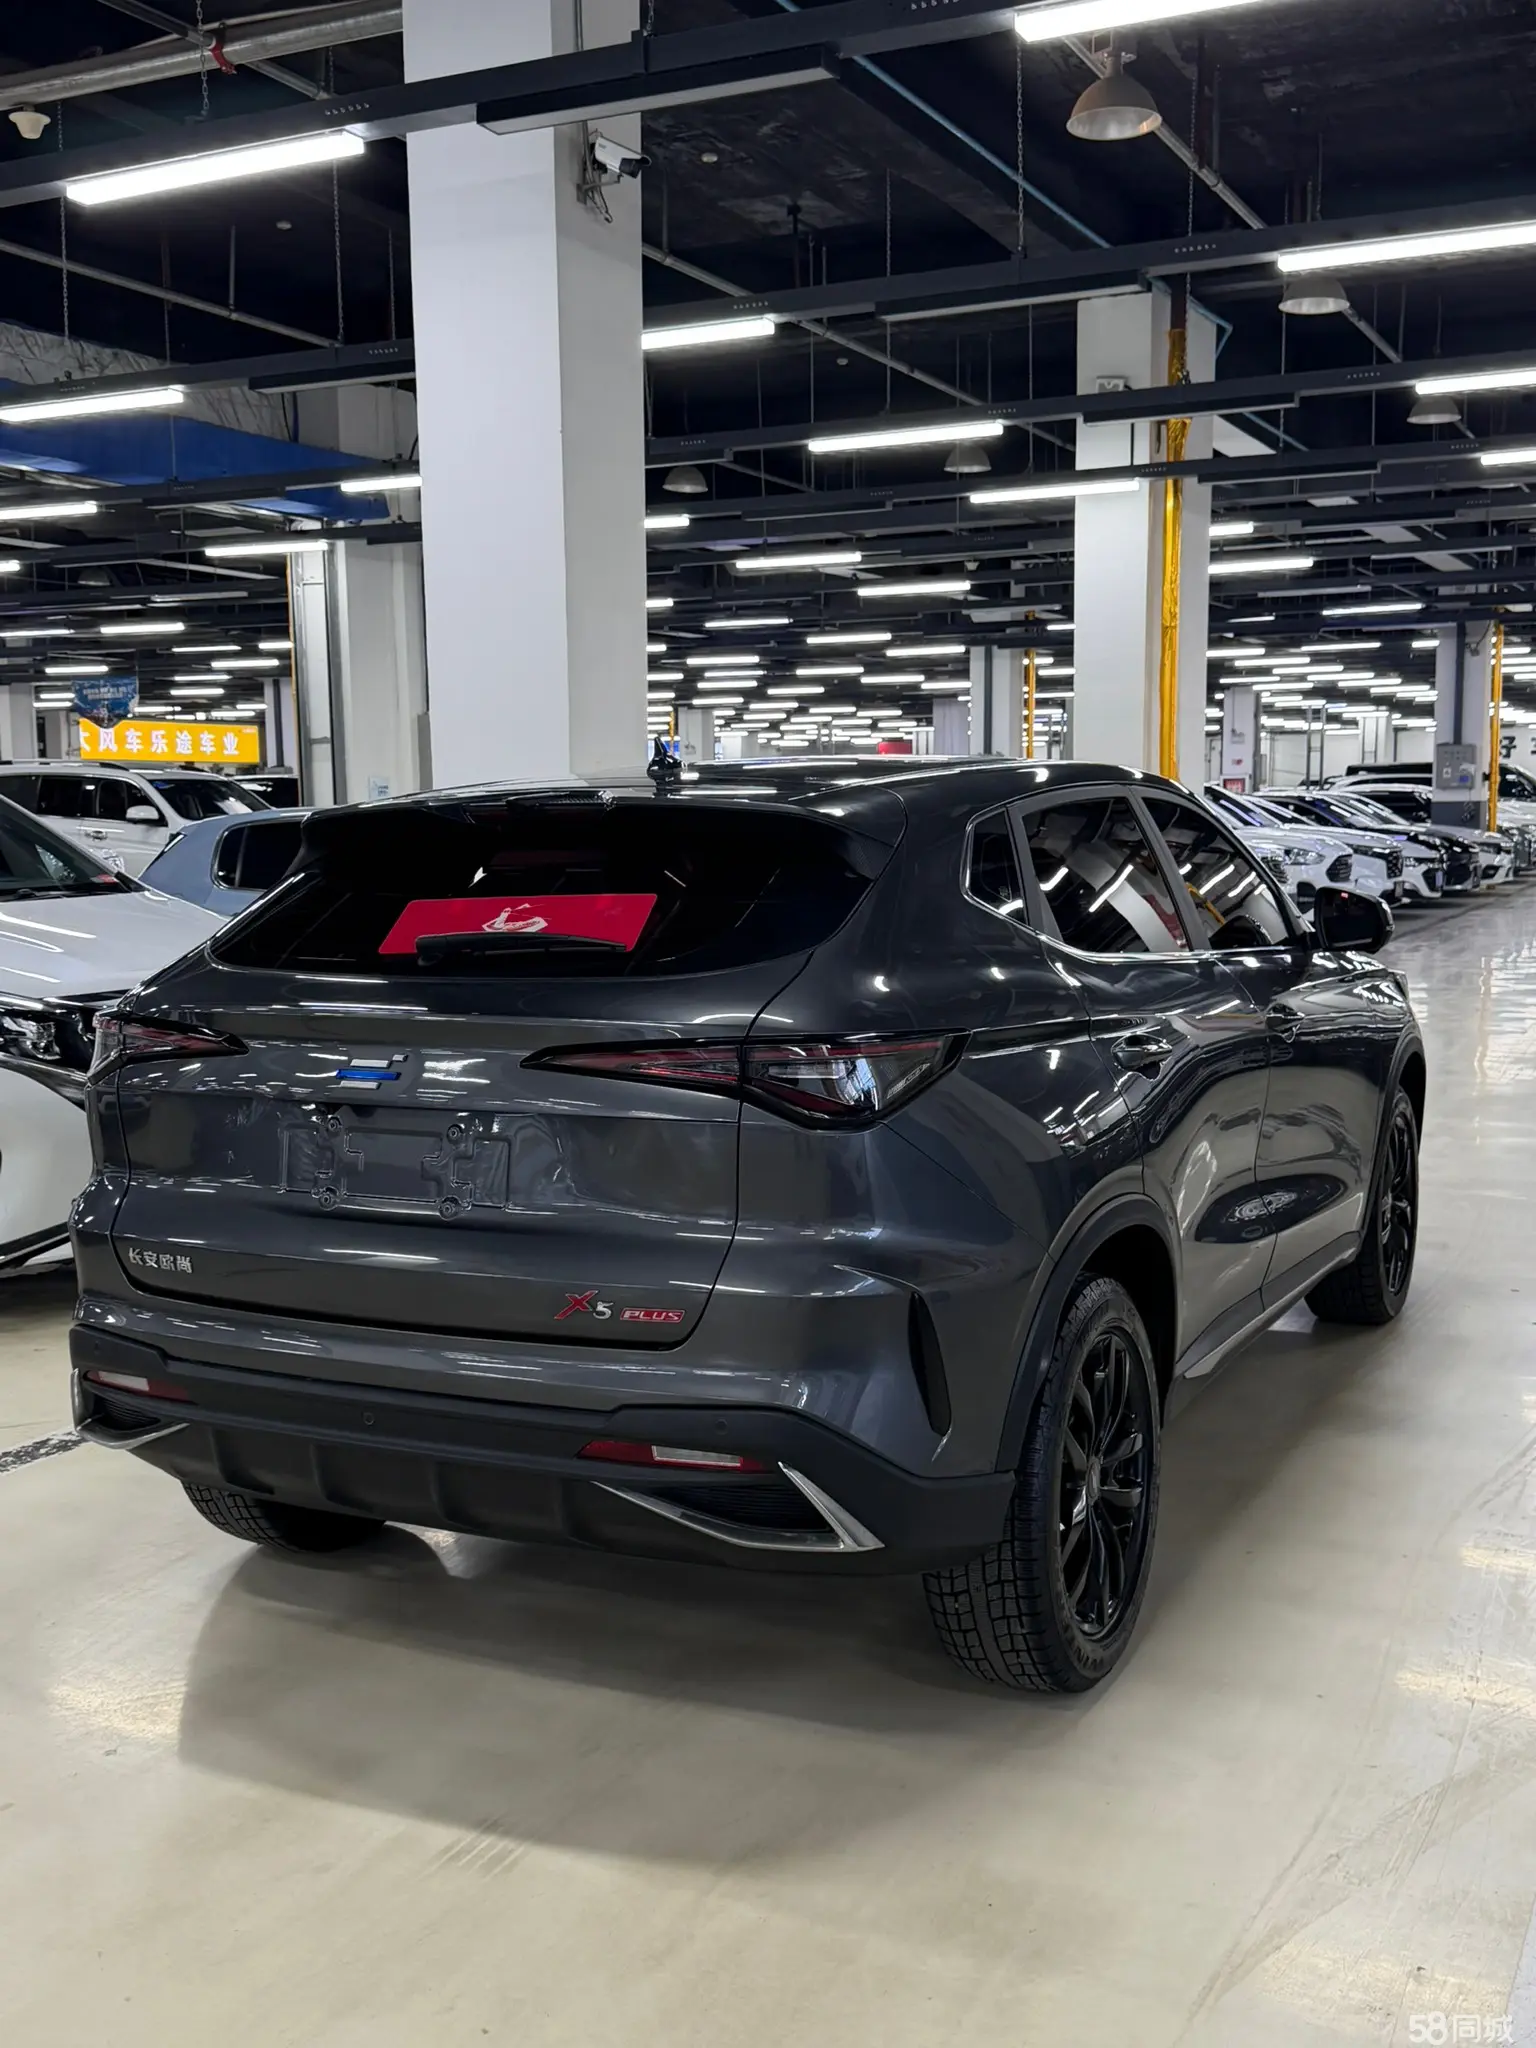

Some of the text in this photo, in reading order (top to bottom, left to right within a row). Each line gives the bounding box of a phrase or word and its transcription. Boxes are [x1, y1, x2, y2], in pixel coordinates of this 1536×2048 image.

[128, 1247, 193, 1274] 长安欧尚
[622, 1309, 682, 1321] PLUS
